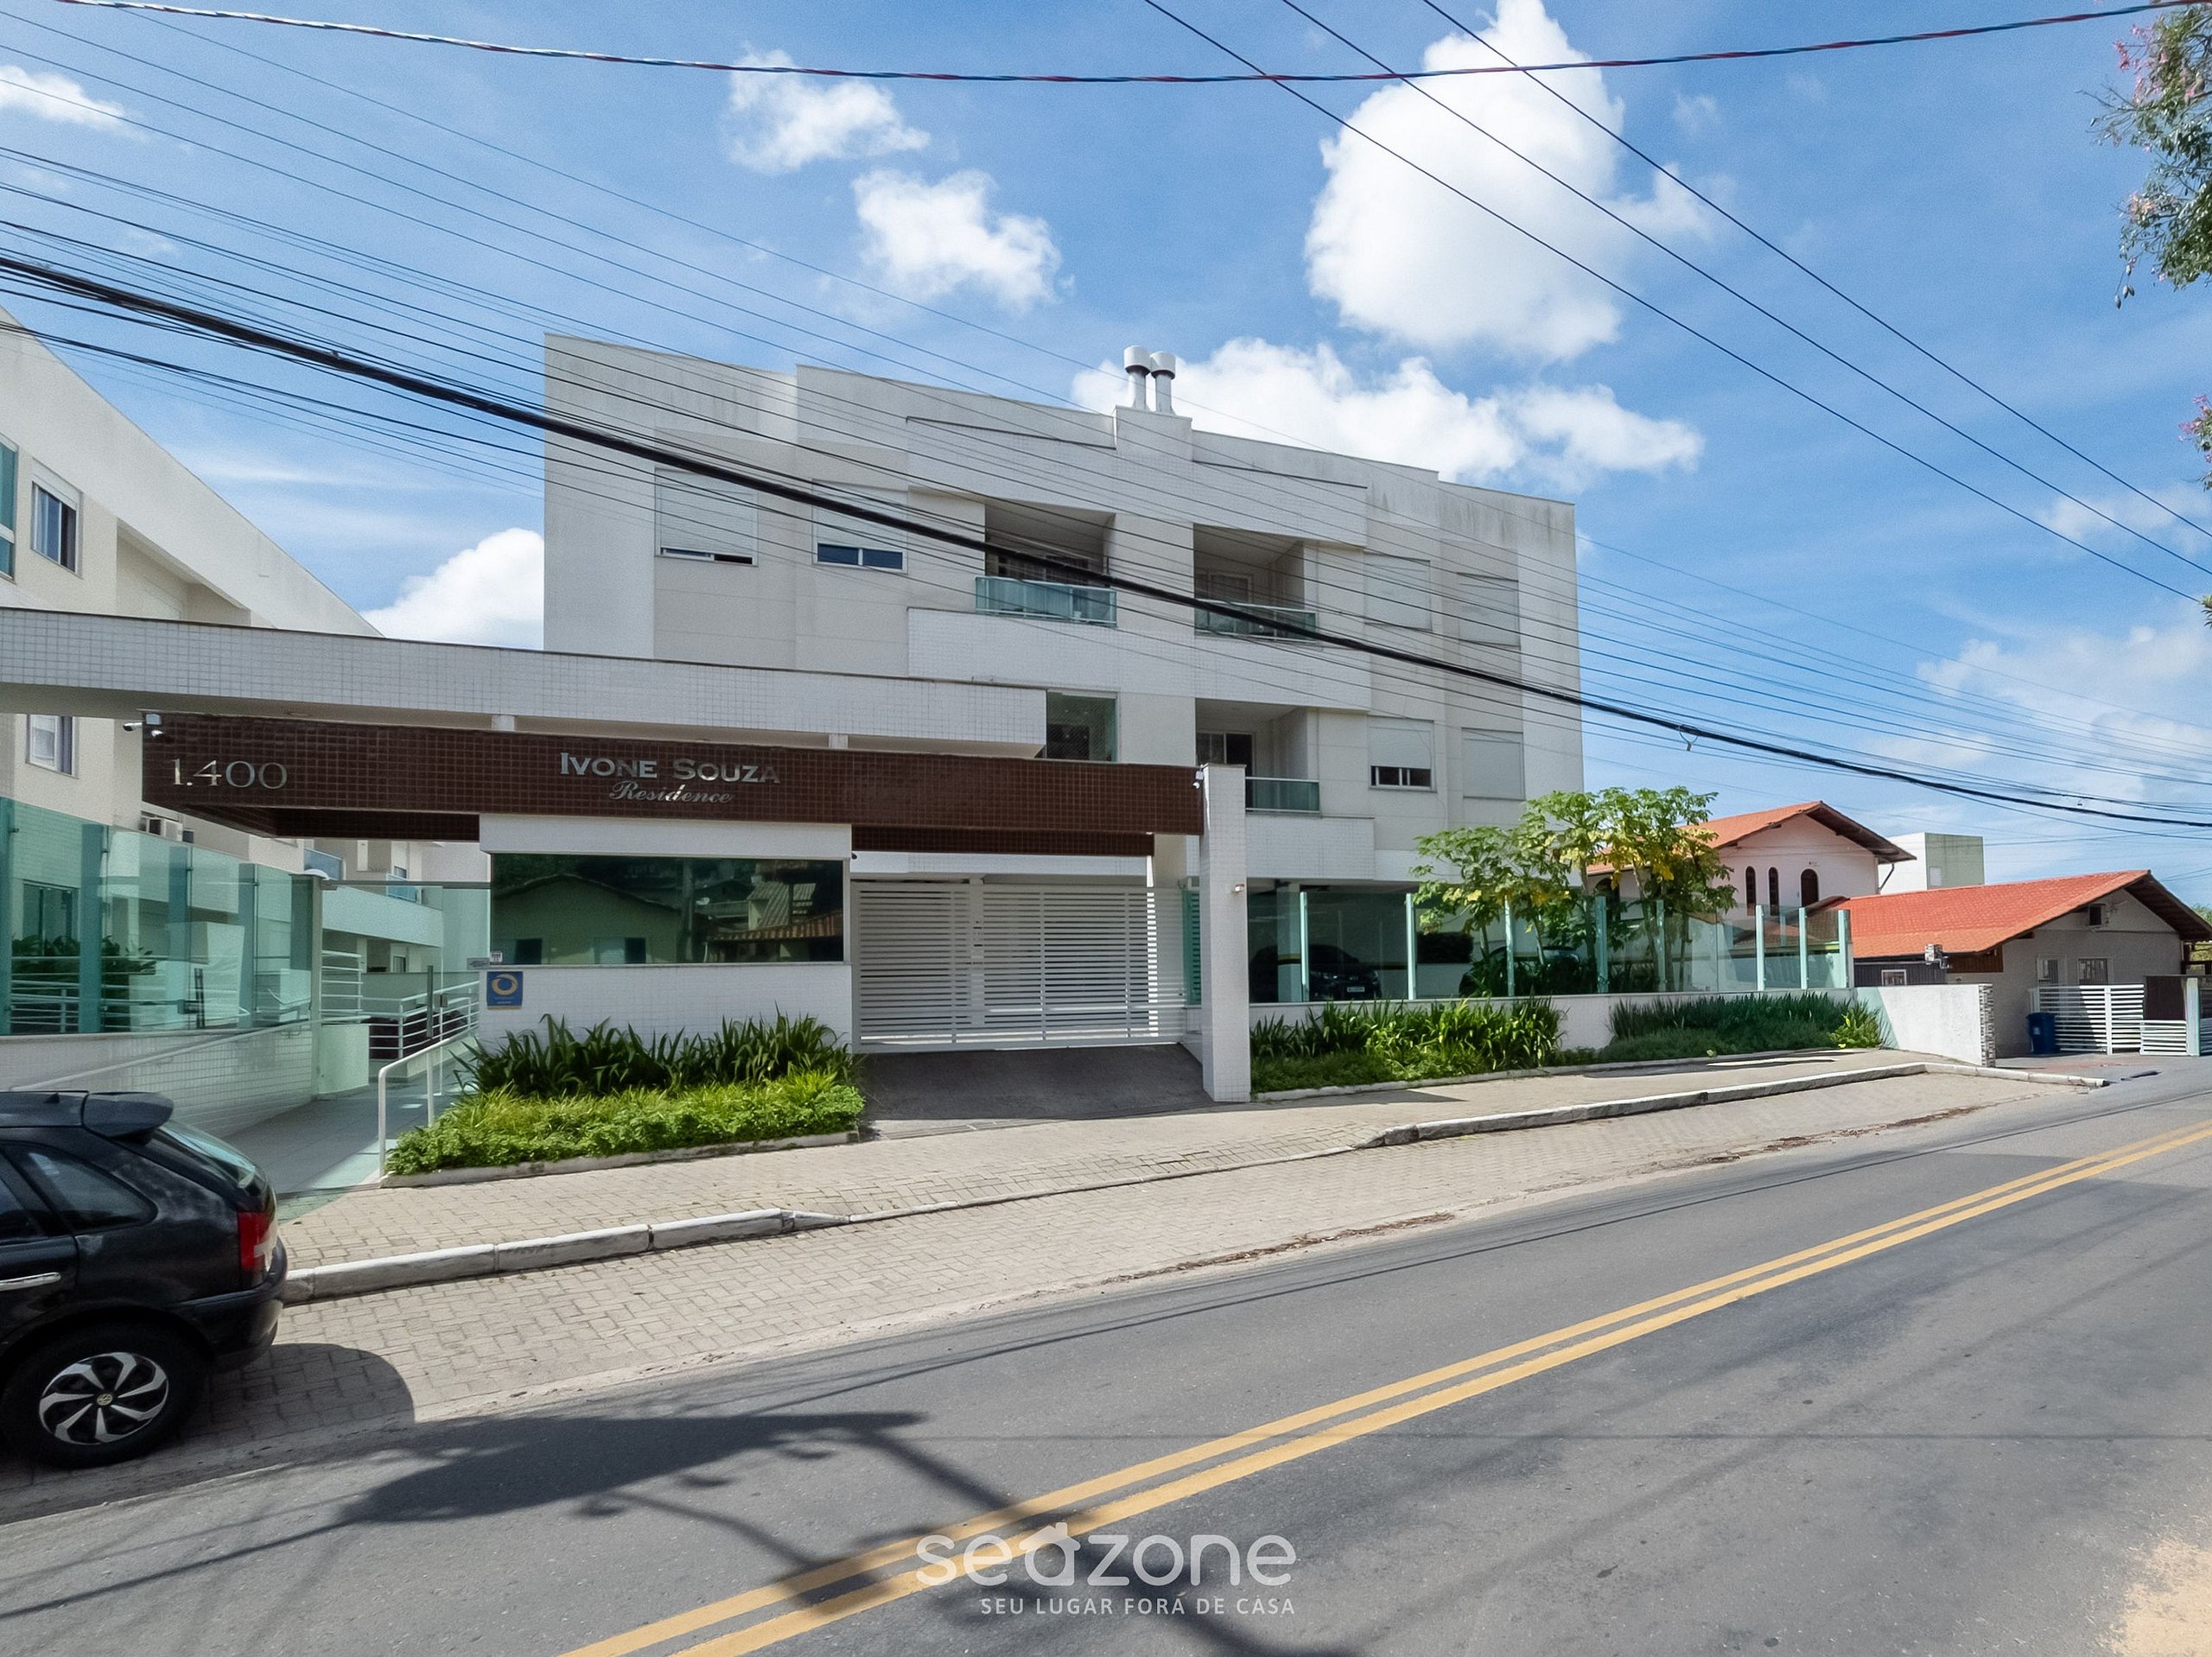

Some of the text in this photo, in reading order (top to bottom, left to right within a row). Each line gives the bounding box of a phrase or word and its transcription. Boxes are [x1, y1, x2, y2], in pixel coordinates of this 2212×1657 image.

[171, 758, 288, 790] 1.400
[560, 752, 780, 784] IVONE SOUZA
[609, 780, 735, 803] Residence
